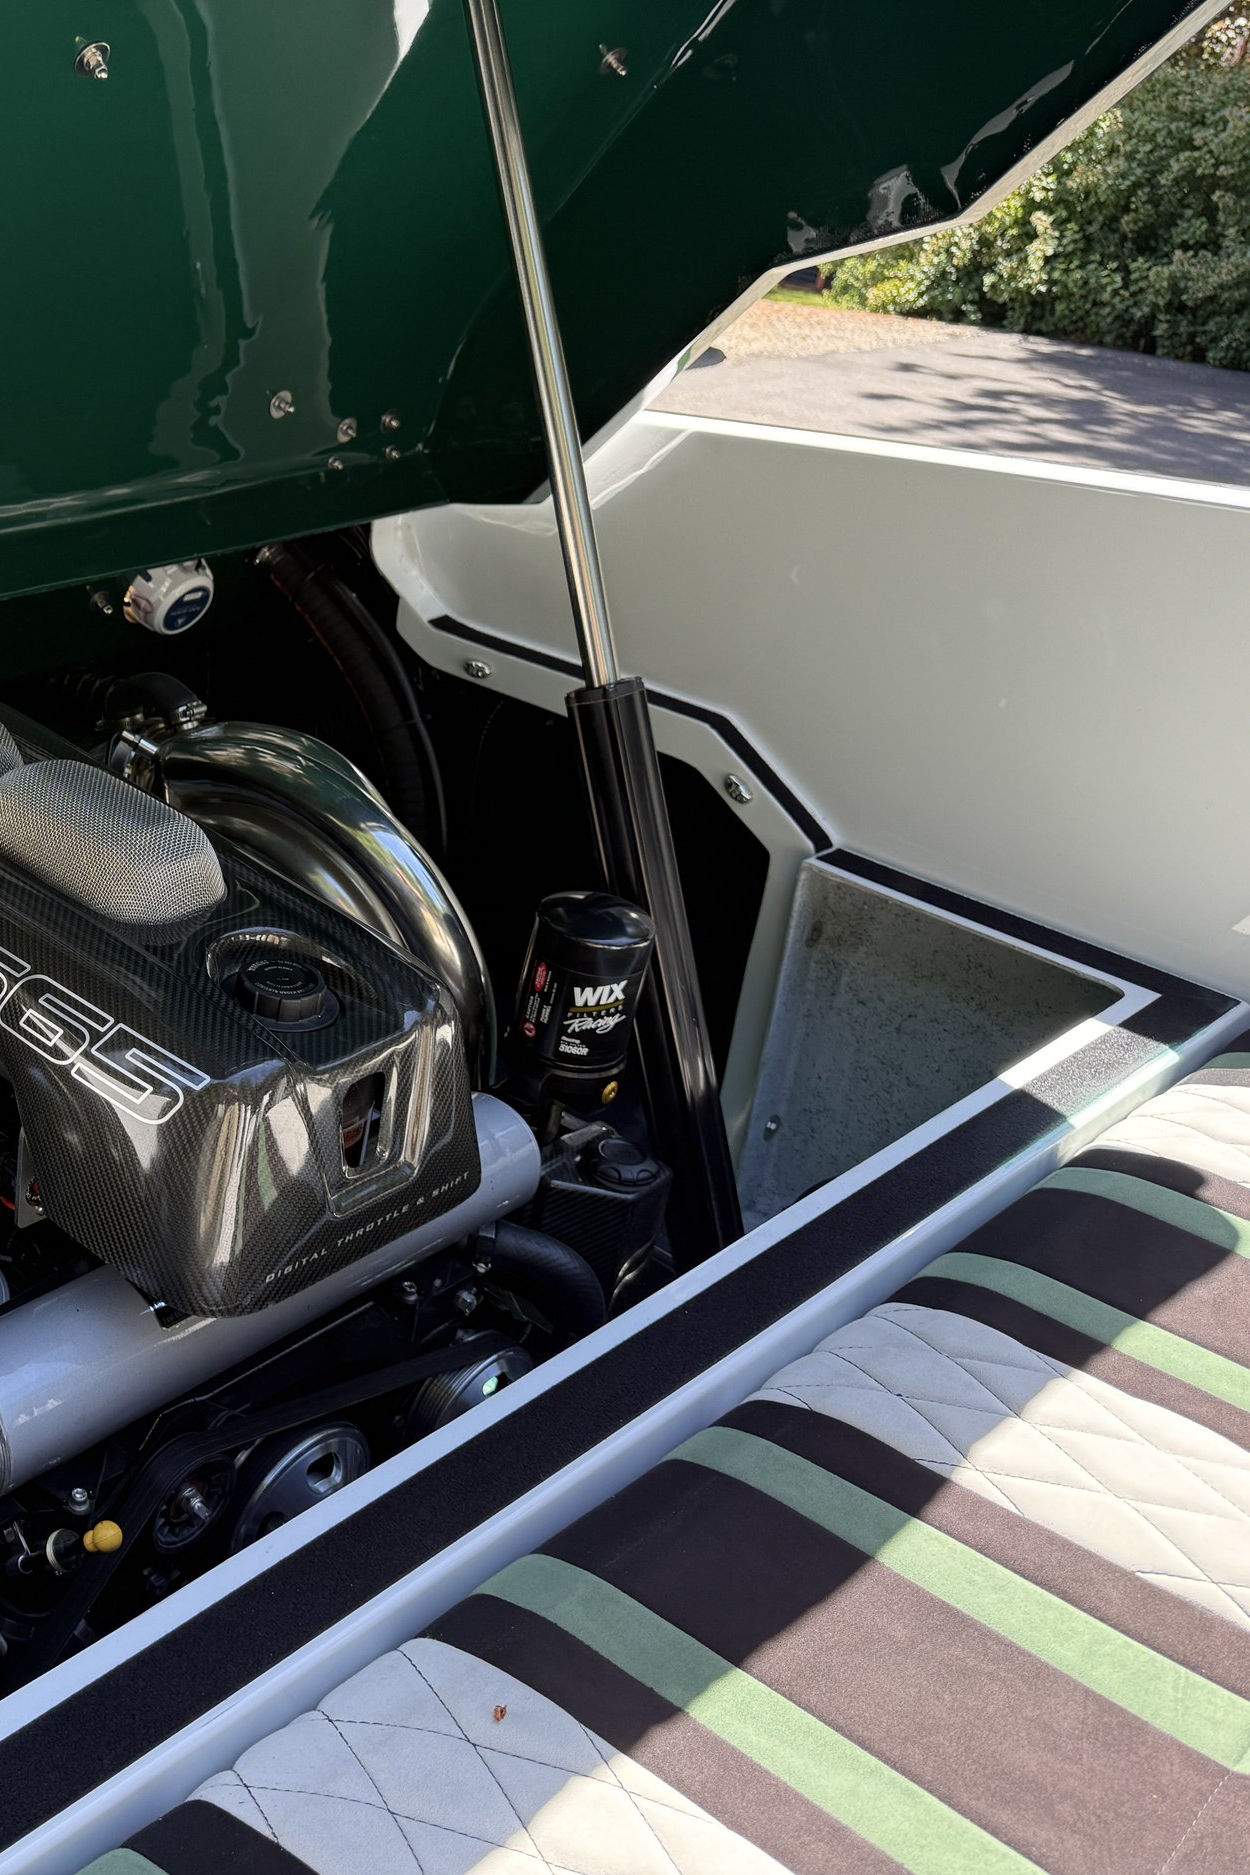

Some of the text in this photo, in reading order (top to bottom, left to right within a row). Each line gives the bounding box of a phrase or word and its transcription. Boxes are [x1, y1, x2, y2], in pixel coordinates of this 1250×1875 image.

[573, 980, 628, 1007] WIX
[567, 1005, 623, 1018] FILTERS
[563, 1013, 627, 1034] Racing
[558, 1045, 589, 1056] 51060R
[264, 1171, 470, 1285] DIGITAL THROTTLE & SHIFT
